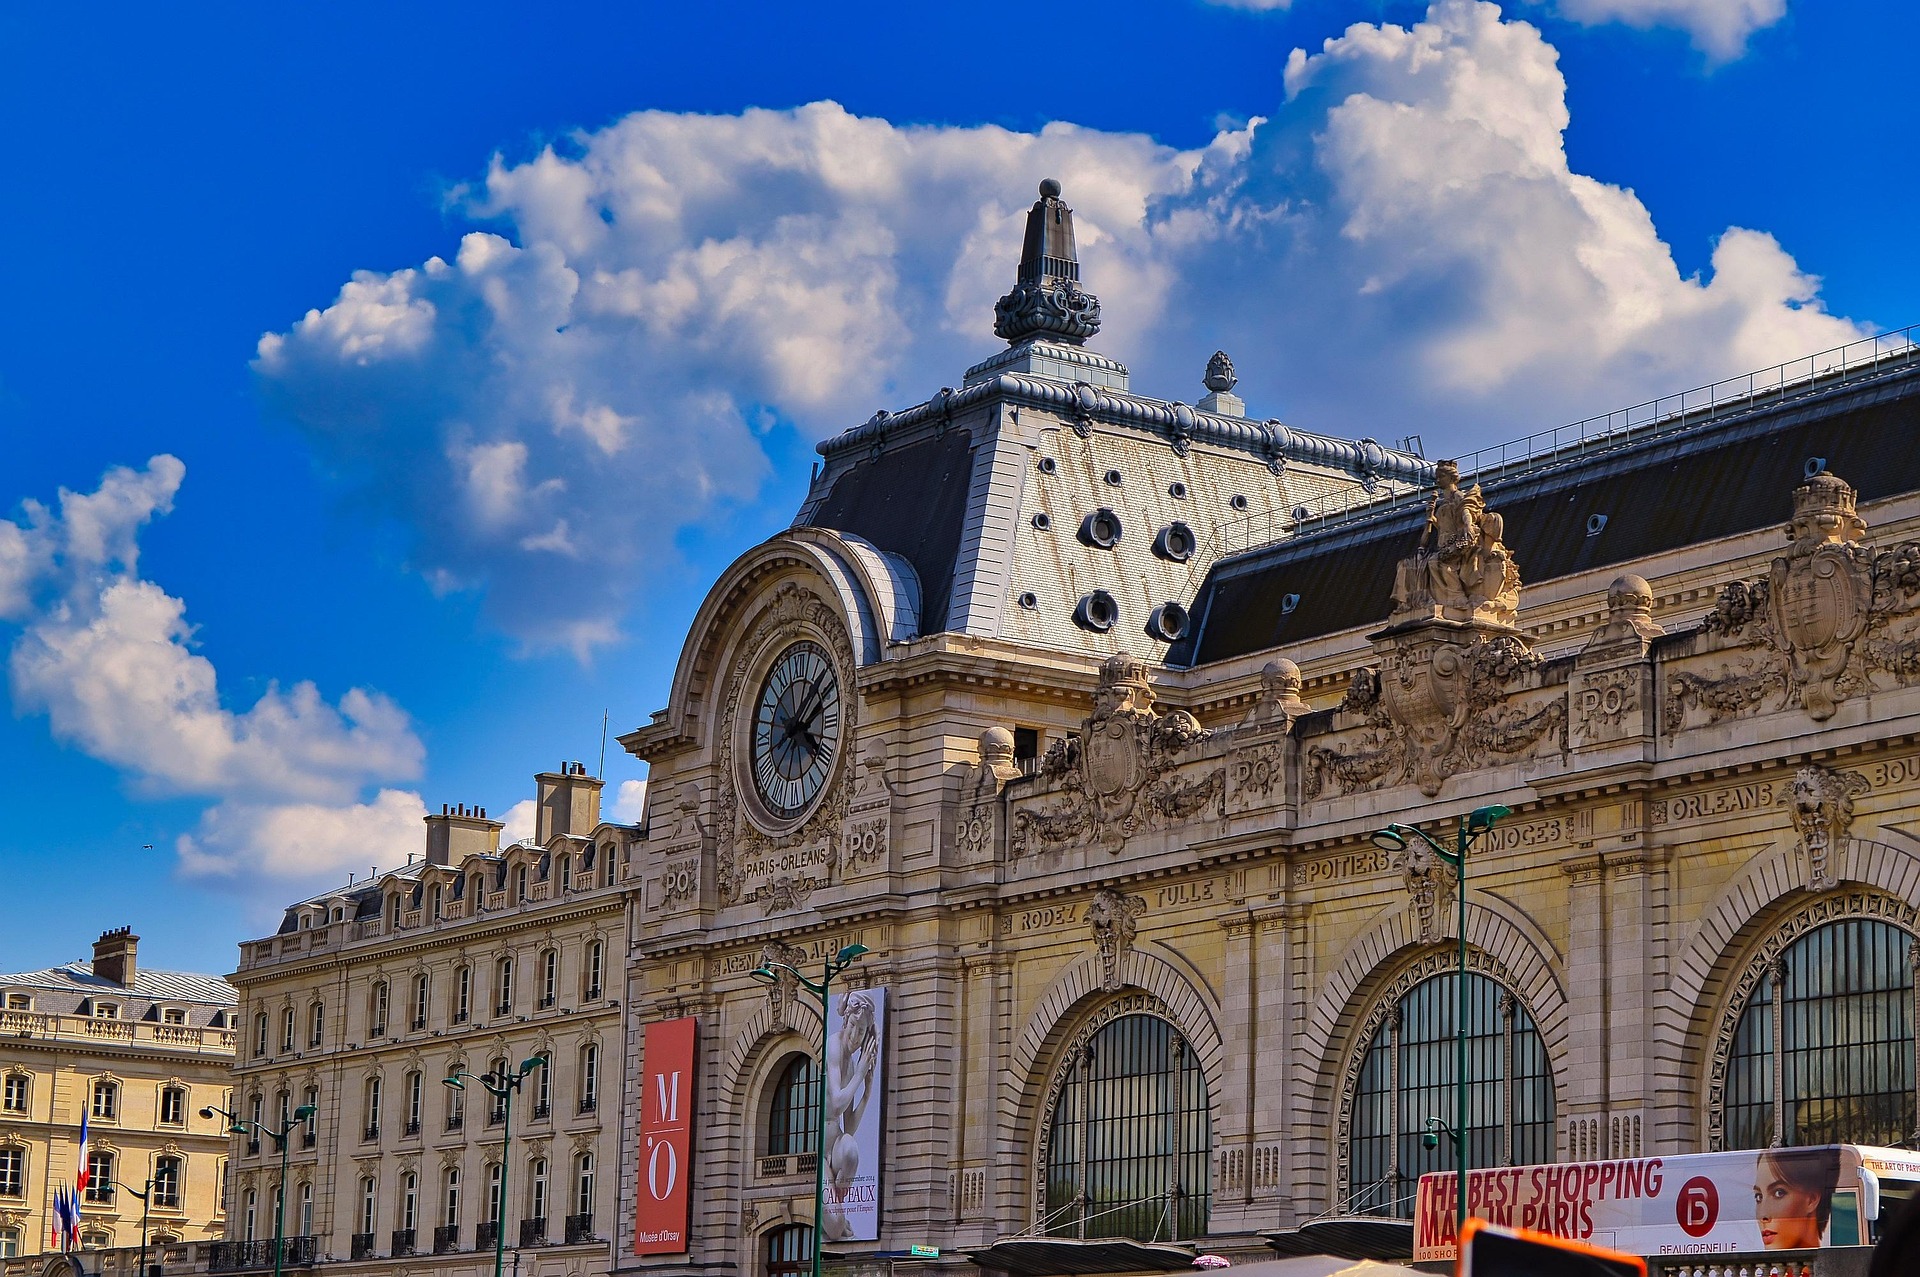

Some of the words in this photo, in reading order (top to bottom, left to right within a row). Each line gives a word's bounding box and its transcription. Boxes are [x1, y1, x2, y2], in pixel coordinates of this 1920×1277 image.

[1671, 784, 1774, 821] ORLEANS
[850, 830, 877, 858] PO
[1471, 820, 1560, 855] LIMOGES
[746, 847, 827, 879] PARIS-ORLEANS
[1308, 850, 1390, 883] POITIERS
[666, 869, 689, 896] PO
[1156, 880, 1214, 908] TULLE
[1021, 904, 1076, 931] RODEZ
[722, 953, 756, 976] AGEN
[653, 1071, 681, 1124] M
[1871, 1161, 1884, 1170] THE
[1885, 1162, 1896, 1171] ART
[1896, 1163, 1905, 1172] OF
[822, 1185, 876, 1205] CARPEAUX
[1421, 1174, 1458, 1212] THE
[1467, 1168, 1524, 1209] BEST
[1530, 1158, 1663, 1206] SHOPPING
[1522, 1200, 1593, 1239] PARIS
[639, 1230, 659, 1243] Musée
[659, 1229, 680, 1242] d'Orsay
[1419, 1251, 1432, 1260] 100
